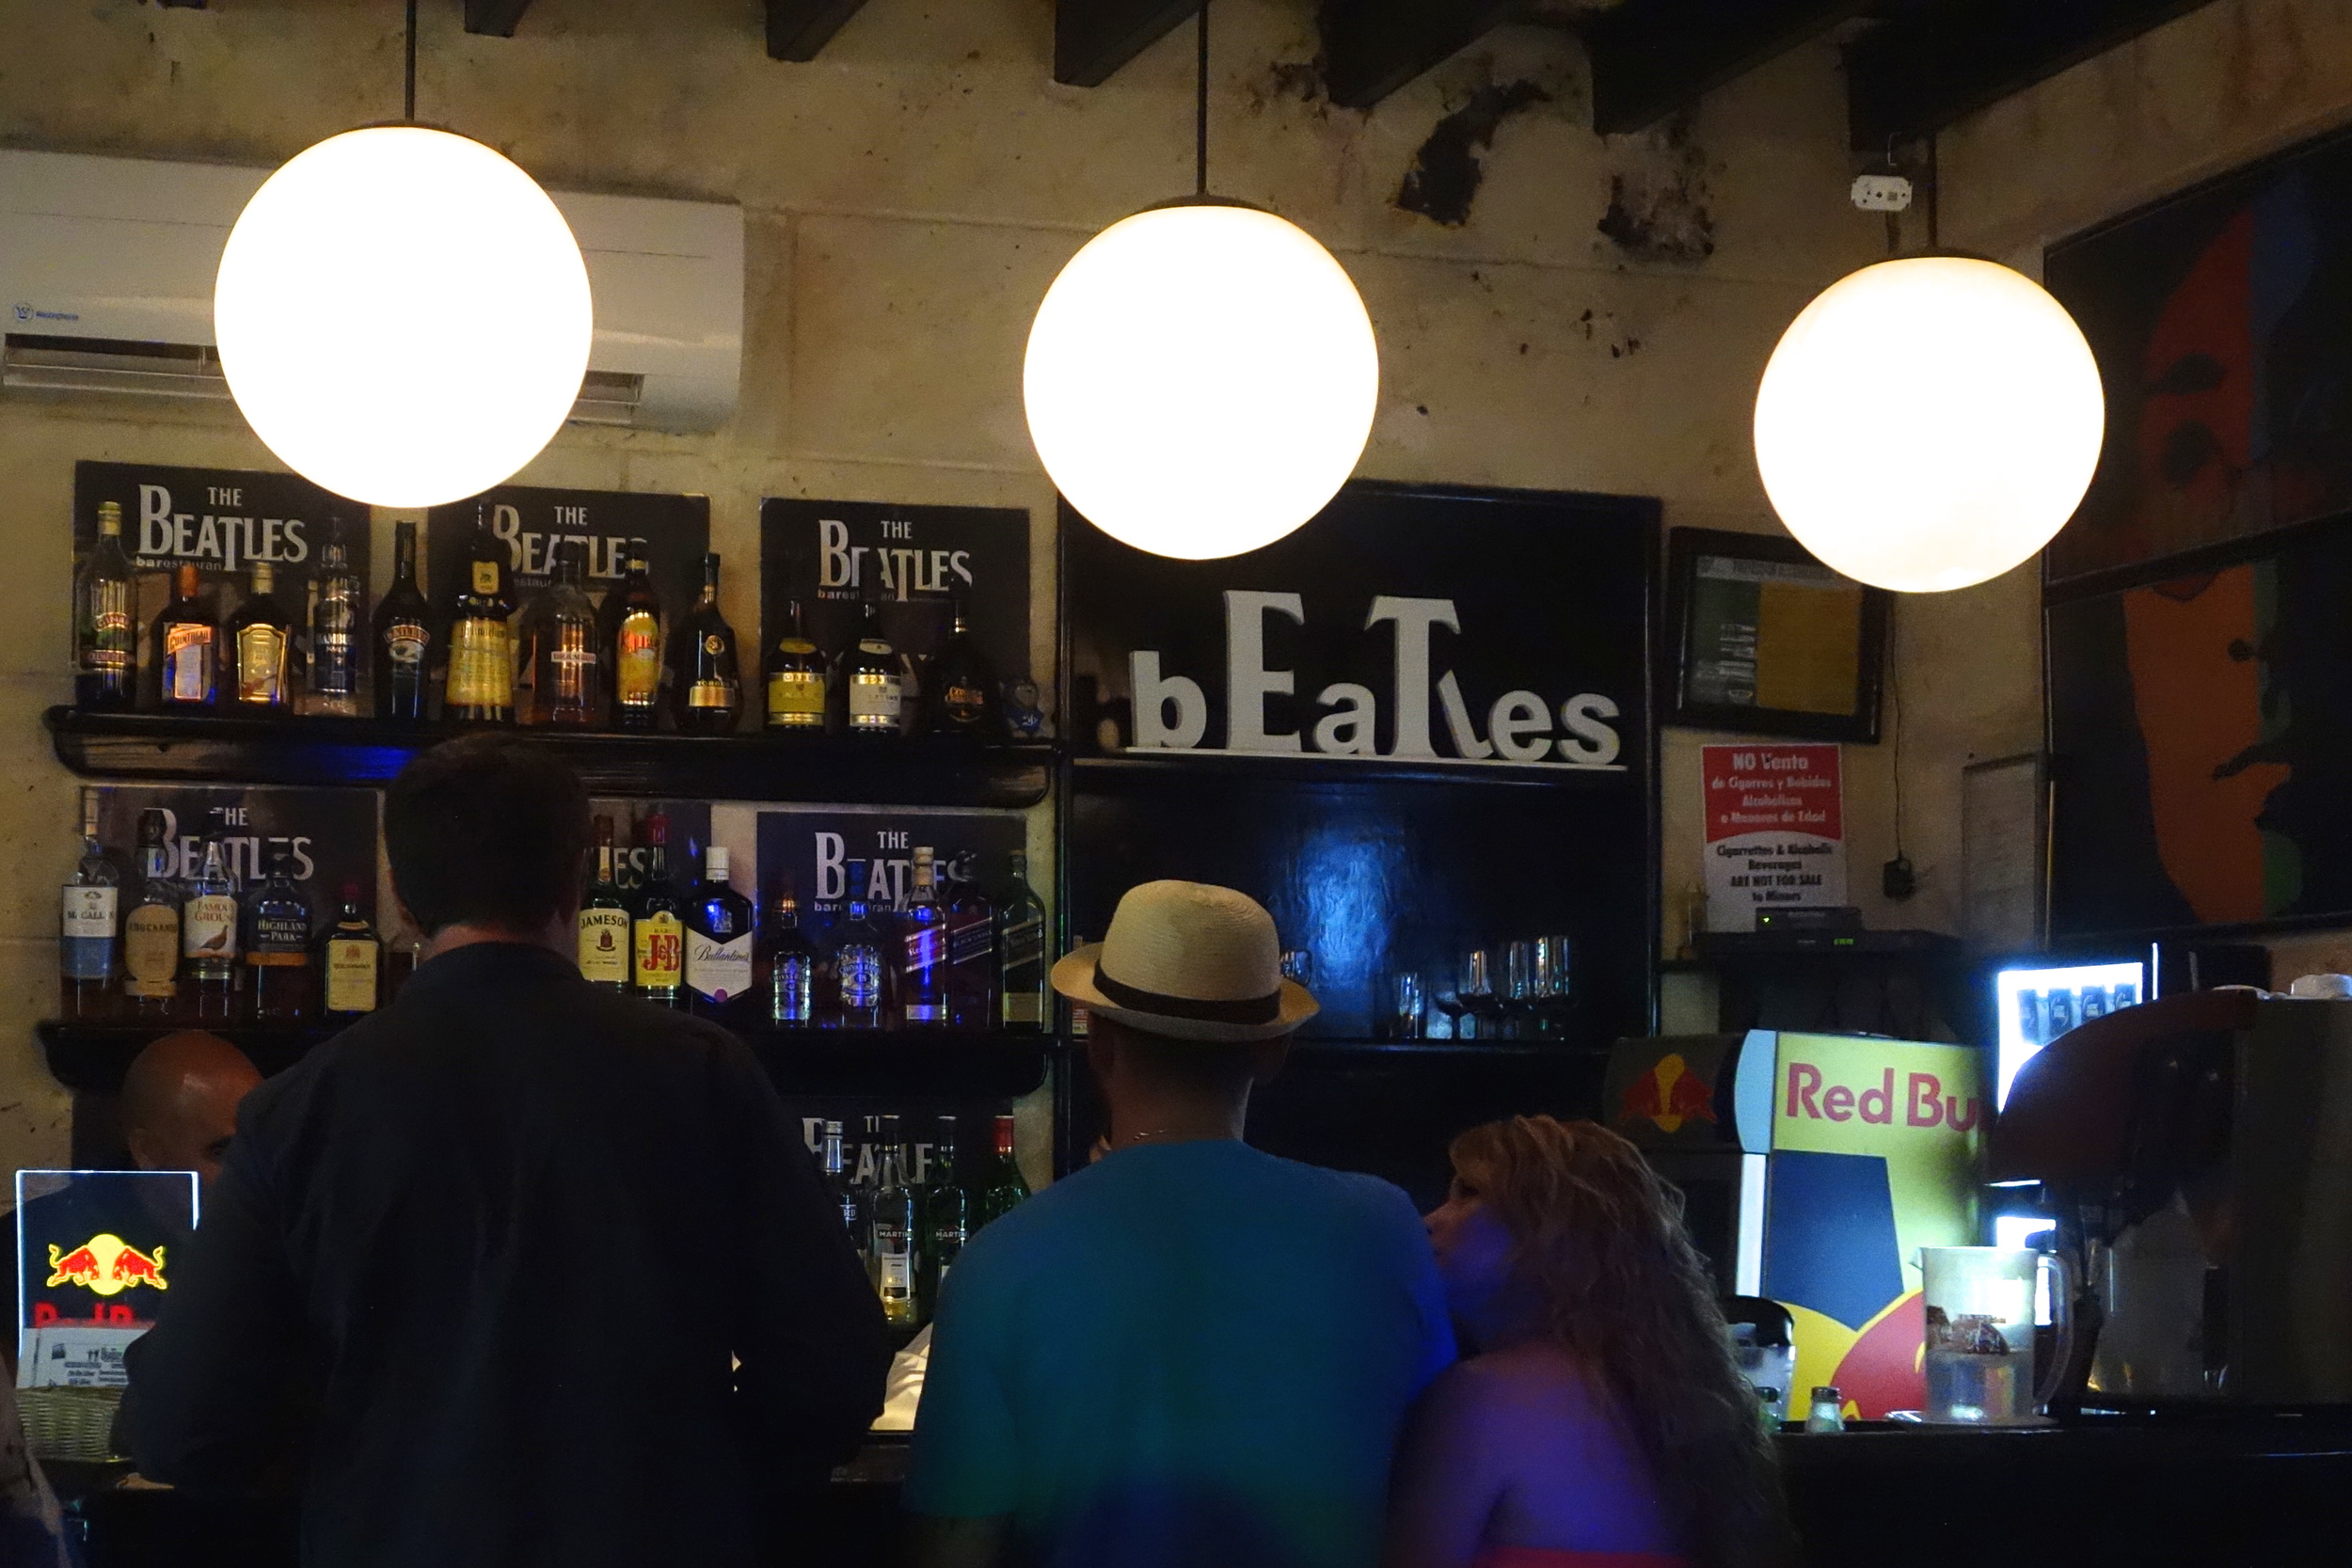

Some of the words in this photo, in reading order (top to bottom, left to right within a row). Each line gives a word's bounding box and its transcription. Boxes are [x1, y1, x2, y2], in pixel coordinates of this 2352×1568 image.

[207, 486, 243, 507] THE
[554, 506, 588, 526] THE
[138, 484, 309, 572] BEATLES
[881, 520, 913, 539] THE
[1733, 753, 1756, 769] NO
[1762, 753, 1809, 769] Venta
[877, 832, 909, 849] THE
[1799, 874, 1822, 886] SALE
[580, 912, 630, 929] JAMESON
[643, 934, 682, 972] J&B
[1787, 1062, 1894, 1125] Red
[1907, 1073, 1979, 1132] Bu
